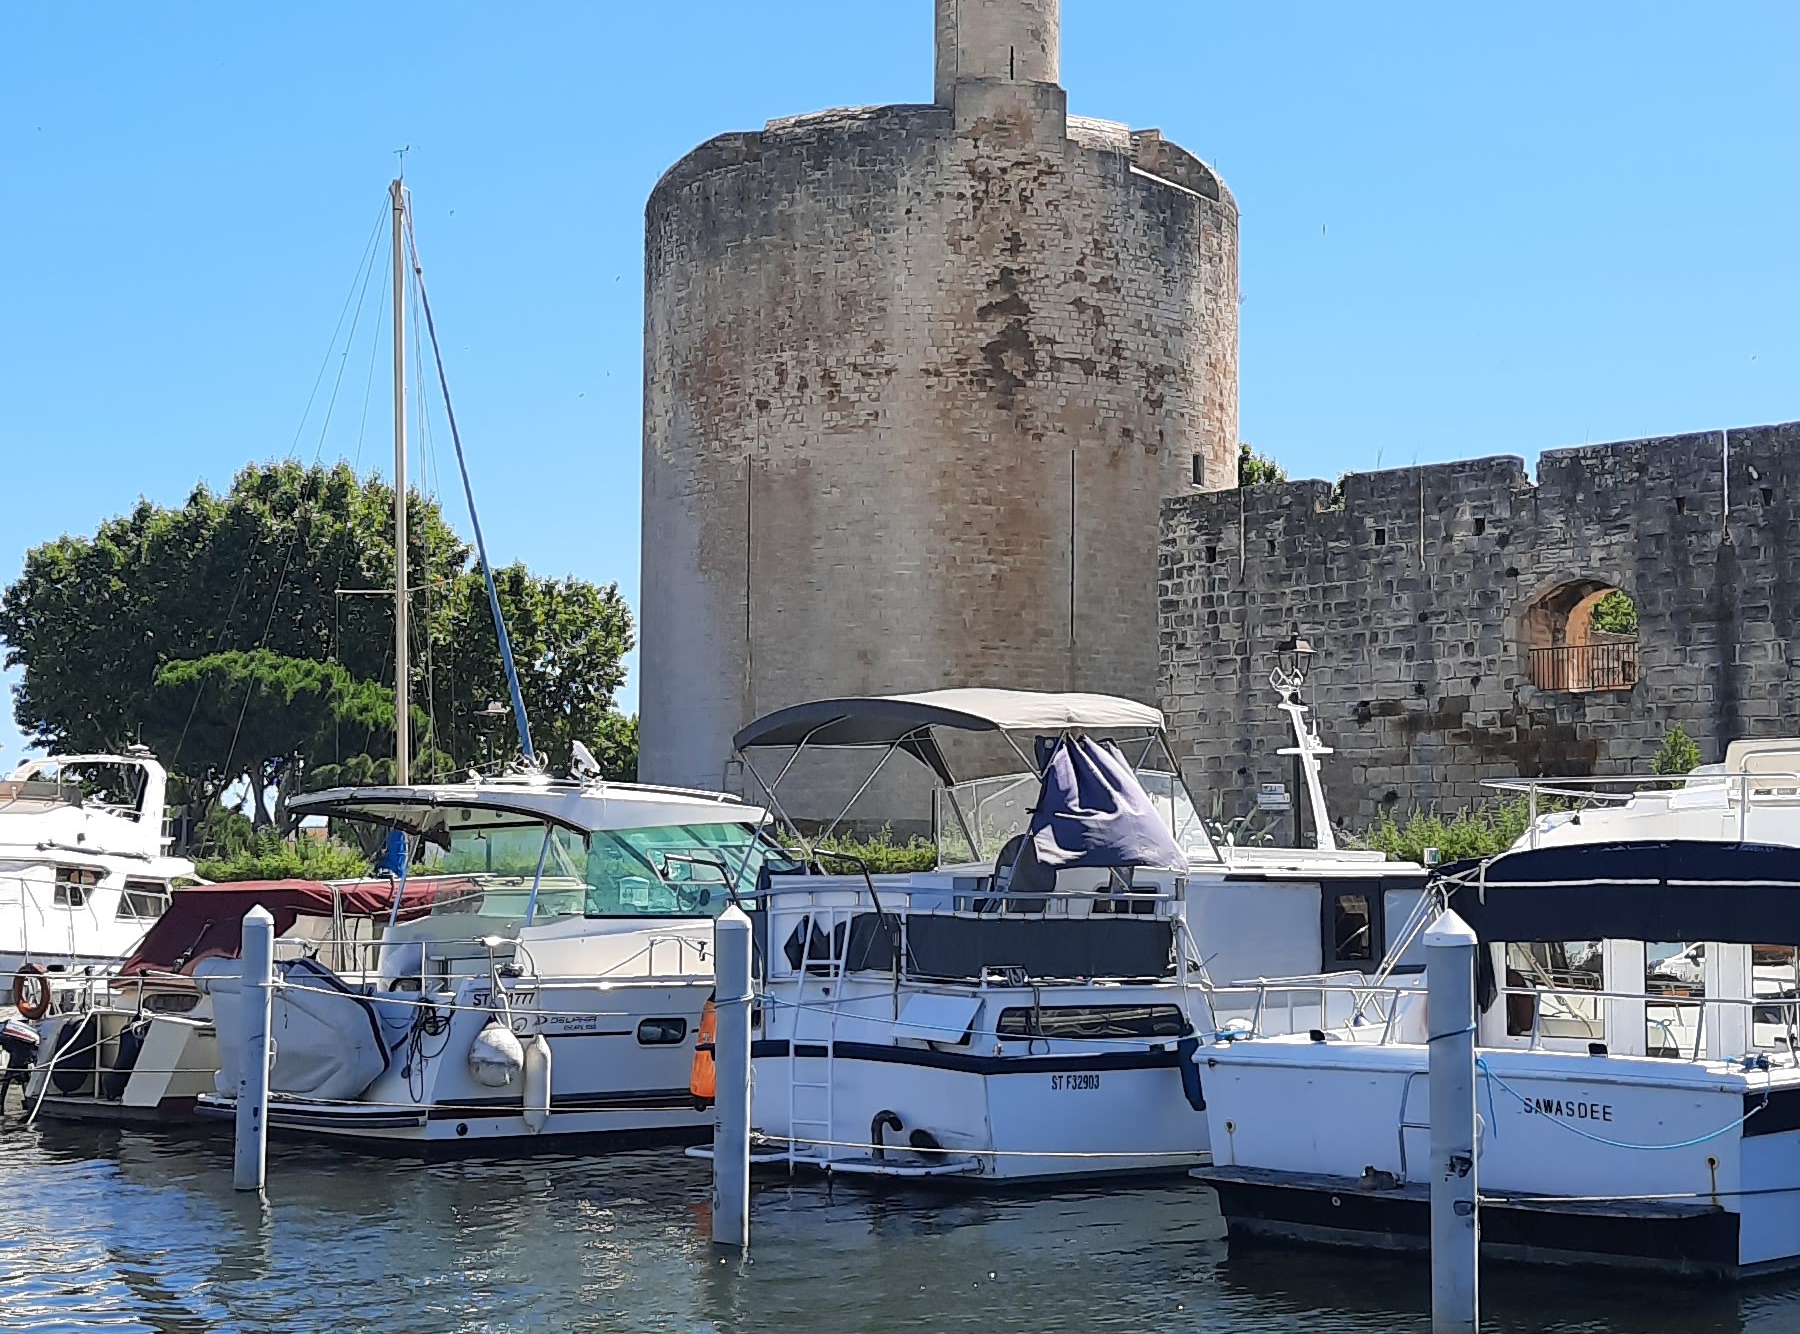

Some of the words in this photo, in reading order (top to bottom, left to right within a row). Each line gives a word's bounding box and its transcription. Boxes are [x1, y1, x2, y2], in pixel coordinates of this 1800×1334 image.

[473, 993, 490, 1006] ST
[1051, 1074, 1063, 1090] ST
[1066, 1074, 1100, 1090] F32903
[1523, 1097, 1613, 1122] SAWASDEE
